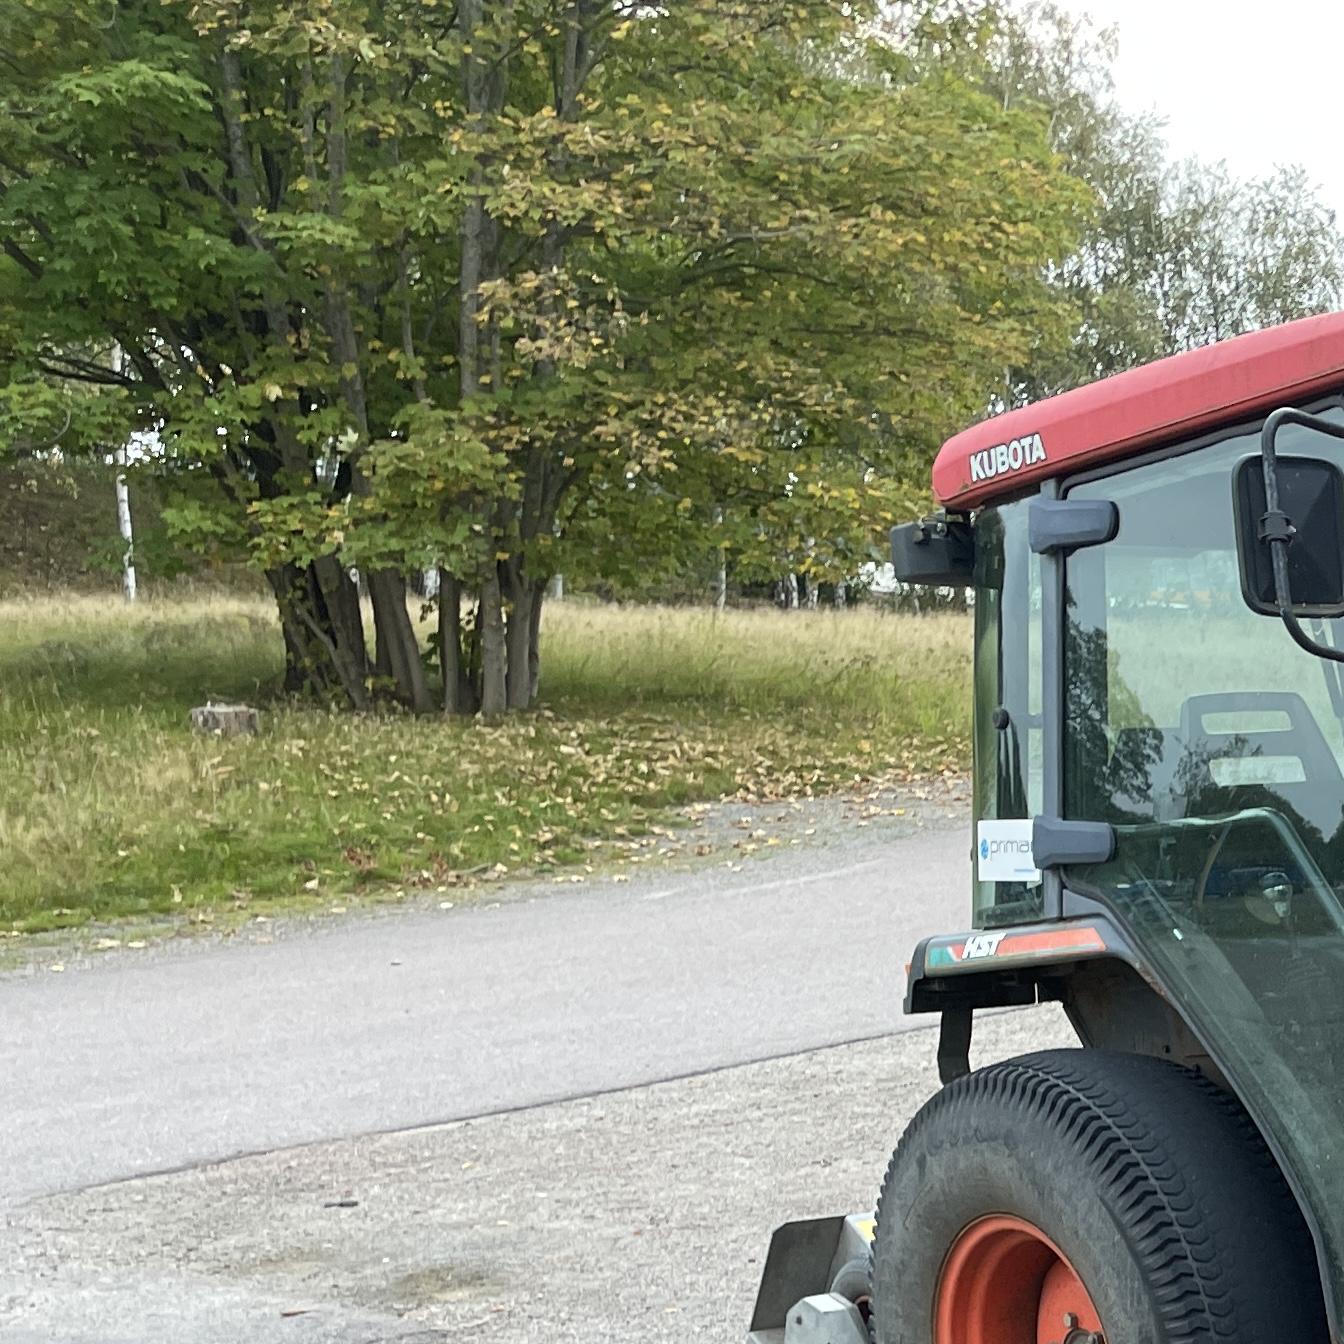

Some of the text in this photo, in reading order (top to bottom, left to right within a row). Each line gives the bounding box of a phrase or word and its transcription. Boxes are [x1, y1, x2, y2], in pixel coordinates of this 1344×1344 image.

[969, 432, 1047, 483] KUBOTA
[990, 838, 1034, 862] prima
[961, 932, 1008, 960] HST
